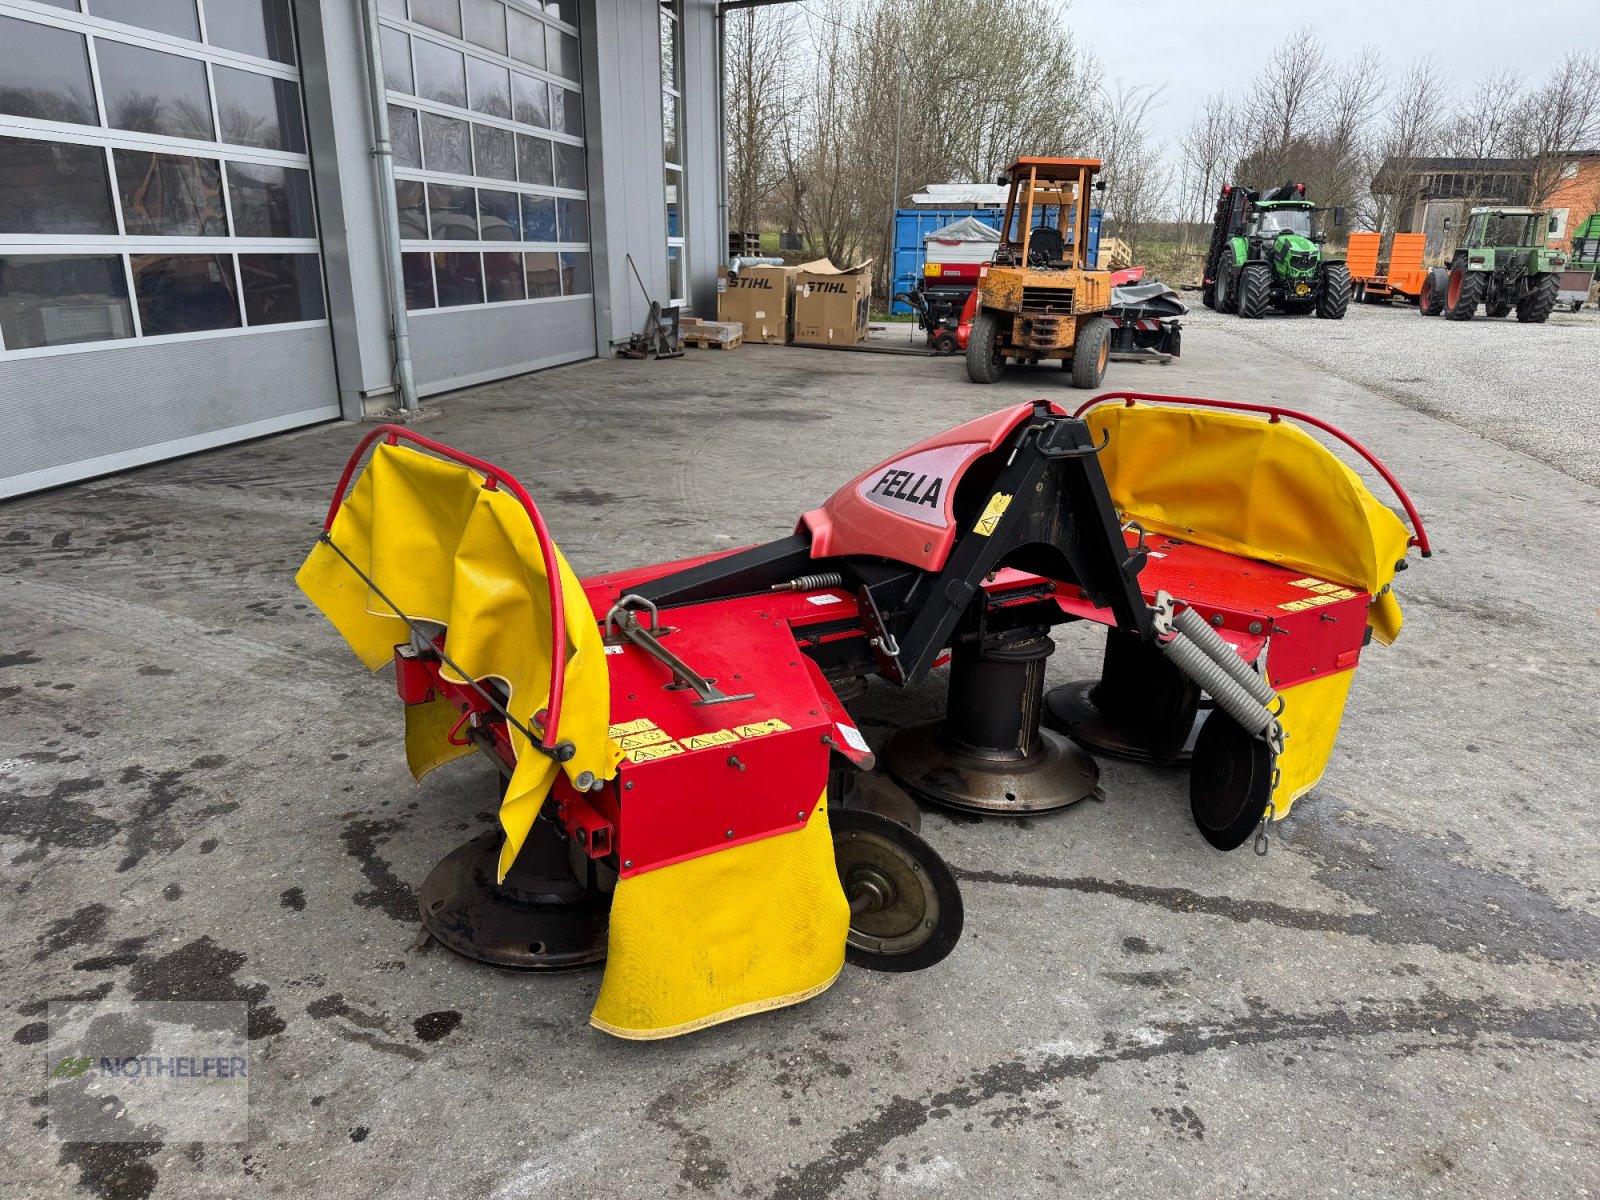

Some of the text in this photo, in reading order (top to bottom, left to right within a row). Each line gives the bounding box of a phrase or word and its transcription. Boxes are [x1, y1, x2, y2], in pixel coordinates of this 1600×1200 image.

[729, 277, 773, 290] STIHL
[807, 281, 848, 294] STIHL
[872, 469, 943, 508] FELLA
